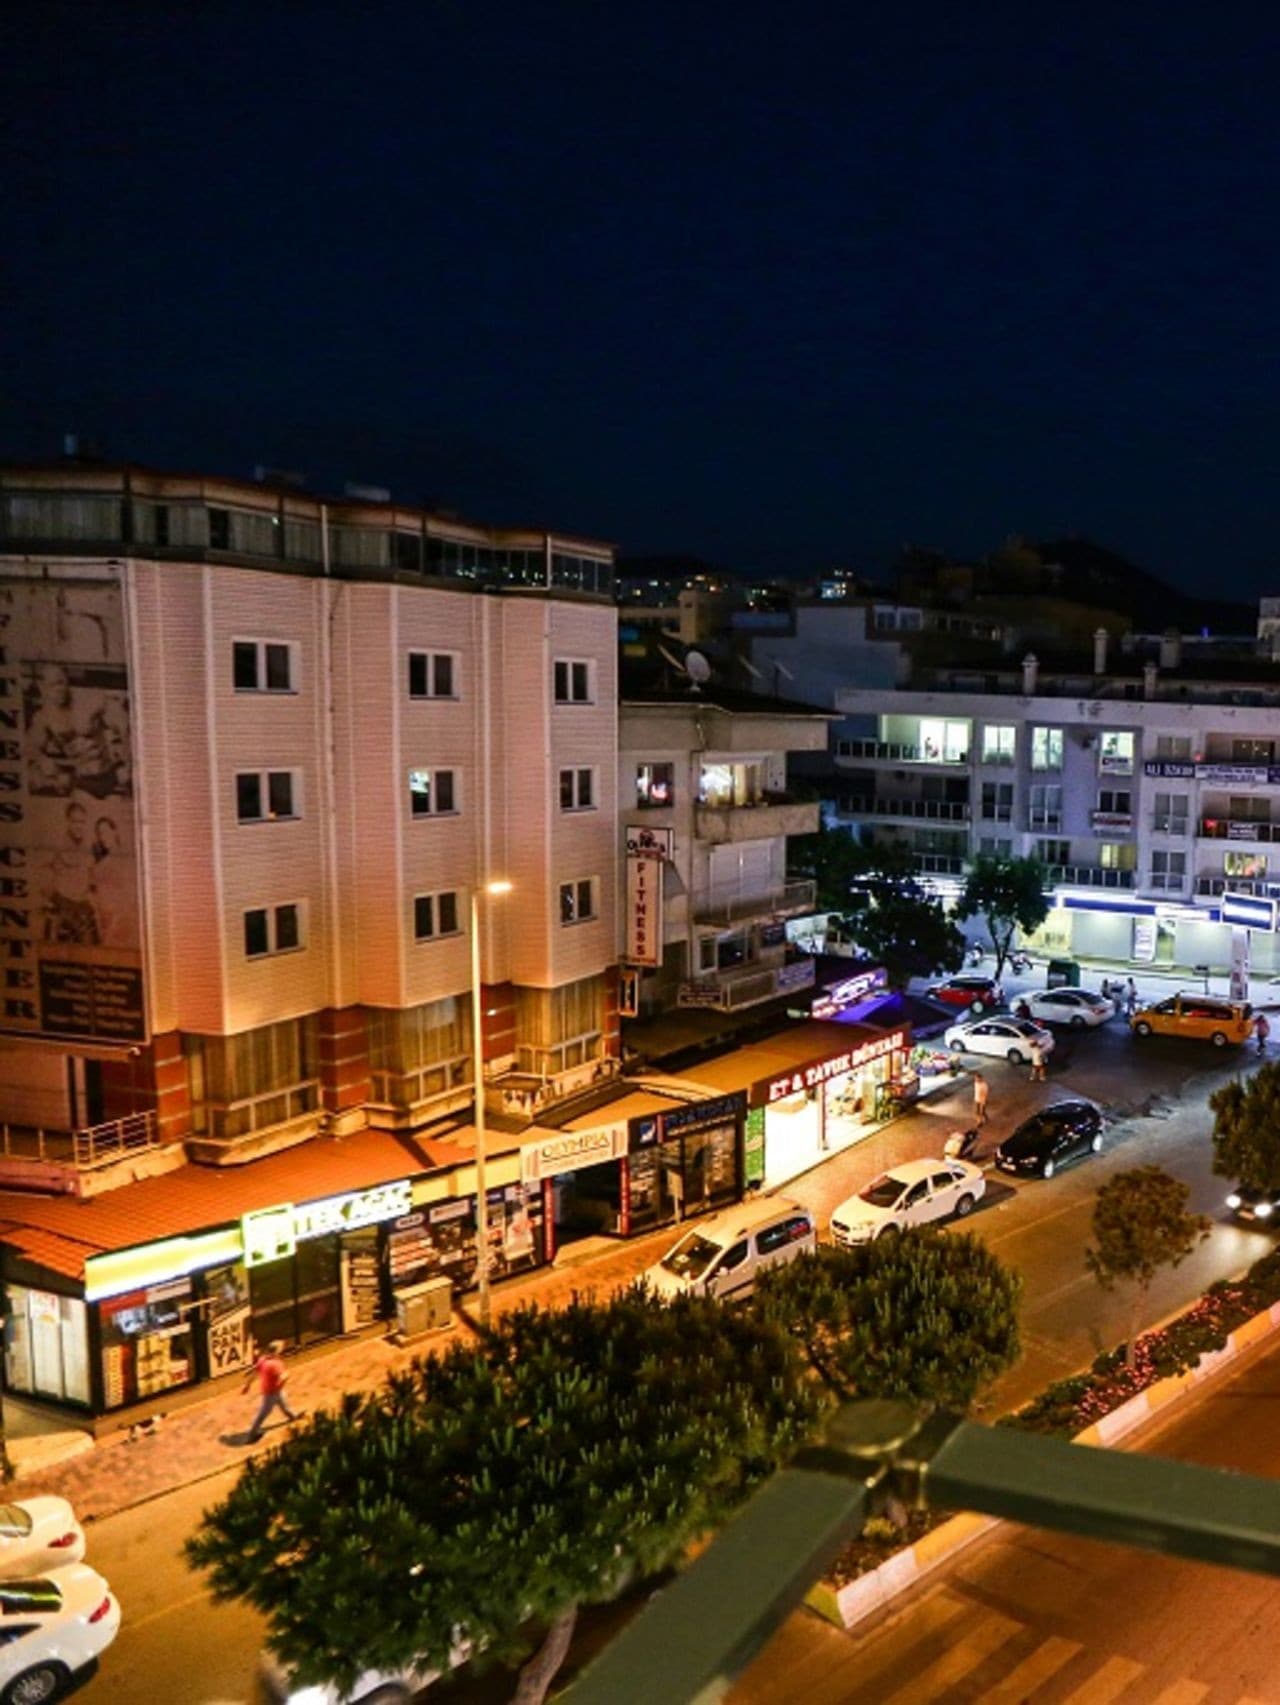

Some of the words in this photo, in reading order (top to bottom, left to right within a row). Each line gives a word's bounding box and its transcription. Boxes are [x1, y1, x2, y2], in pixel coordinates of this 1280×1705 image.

[0, 847, 37, 1018] CENTER
[635, 862, 647, 956] FITNESS
[769, 1078, 790, 1101] ET
[805, 1054, 850, 1086] TAVUK
[212, 1335, 241, 1349] PAN
